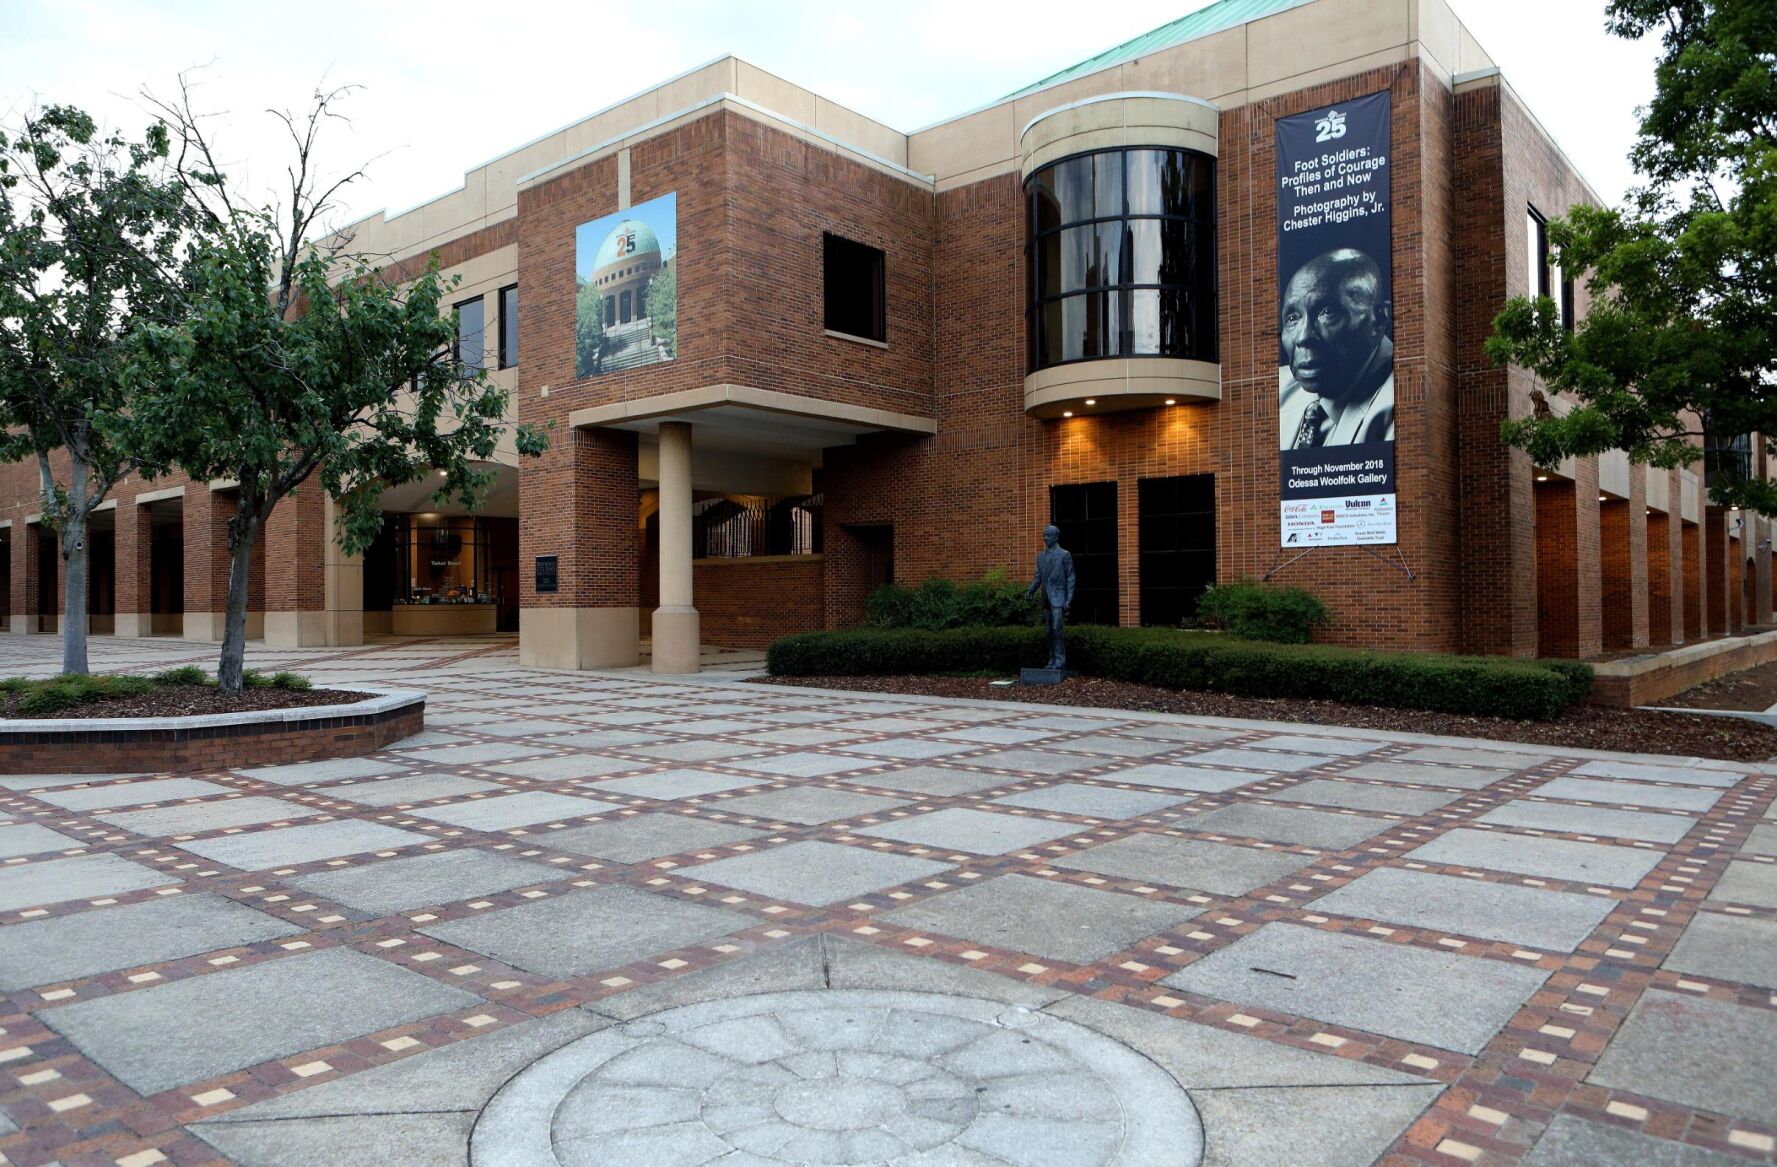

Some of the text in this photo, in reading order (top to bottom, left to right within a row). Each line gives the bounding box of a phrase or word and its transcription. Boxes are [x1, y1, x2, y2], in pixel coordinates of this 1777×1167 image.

[1316, 116, 1346, 142] 25
[1282, 156, 1385, 188] Profiles of Courage
[1295, 146, 1370, 172] Foot Soldiers:
[1294, 172, 1372, 197] Then and Now
[1284, 202, 1384, 231] Chester Higgins, Jr.
[1294, 191, 1376, 217] Photography by
[616, 234, 636, 257] 25
[1288, 473, 1387, 488] Odessa Woolfolk Gallery
[1292, 460, 1384, 475] Through November 2018
